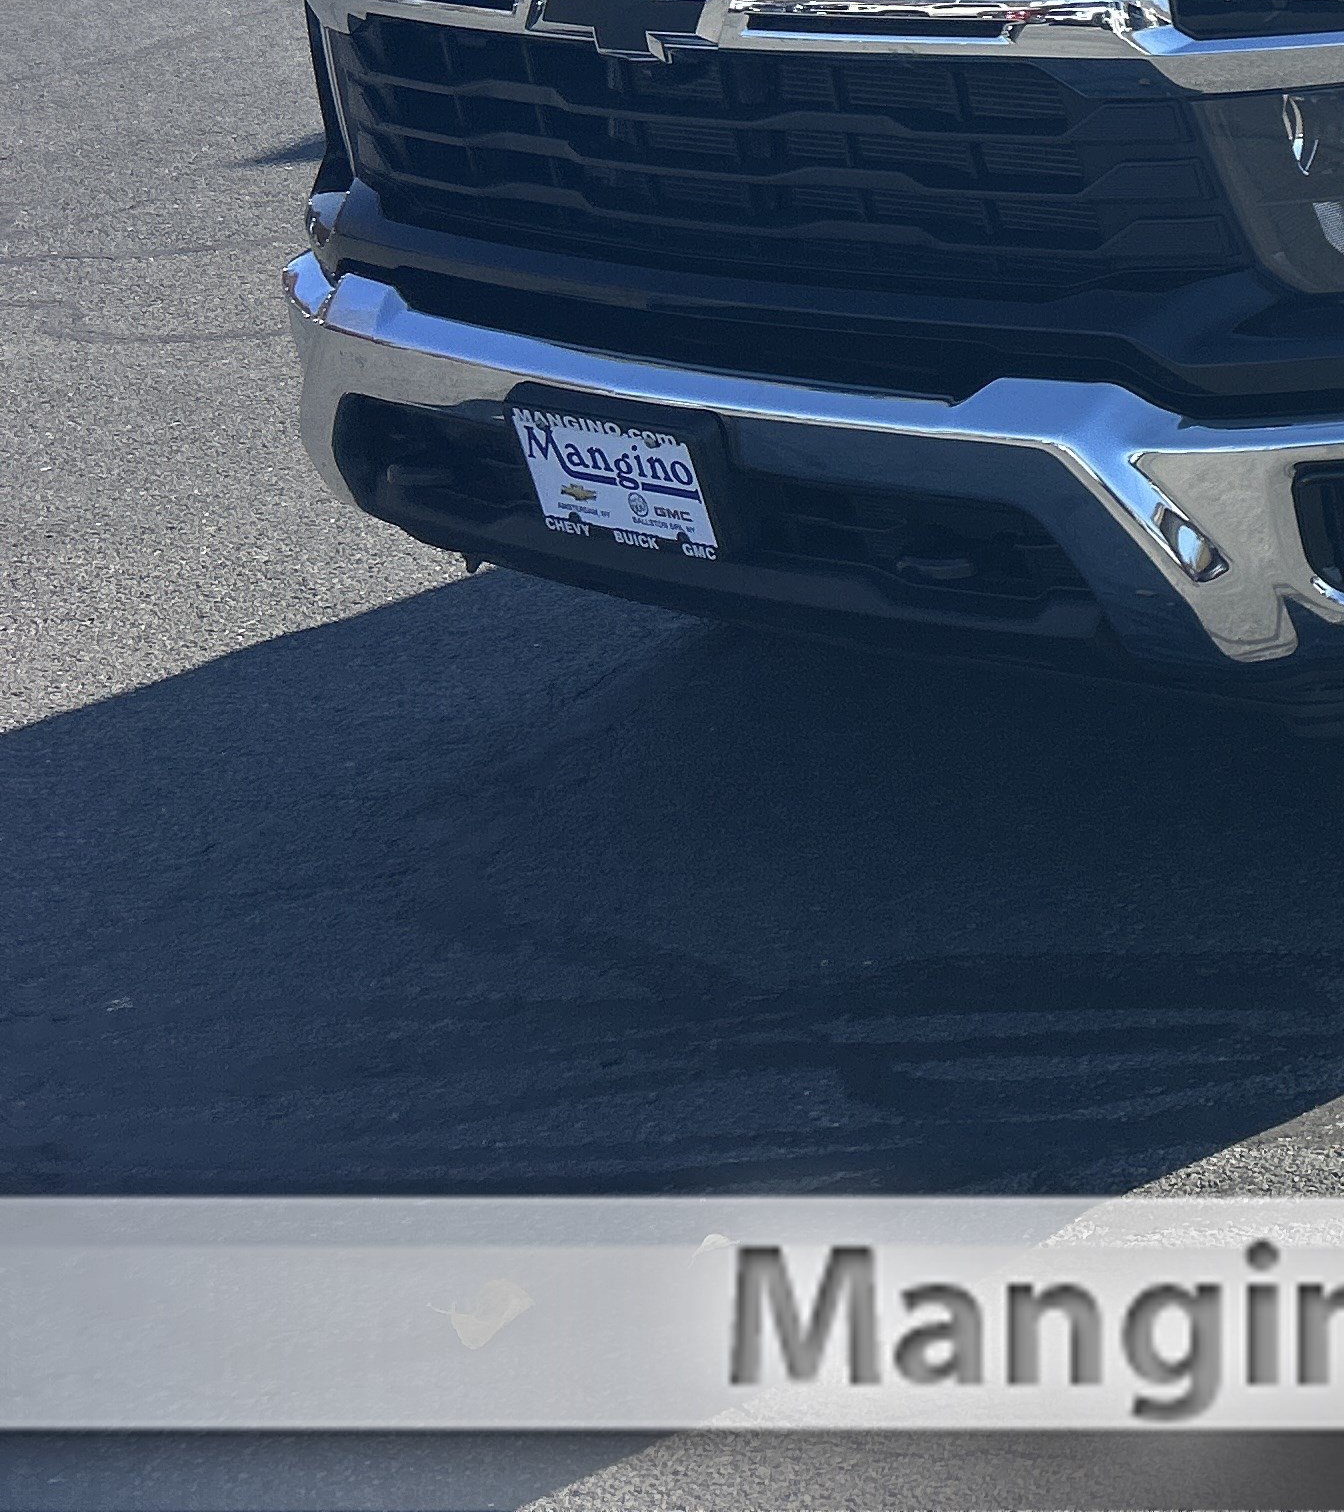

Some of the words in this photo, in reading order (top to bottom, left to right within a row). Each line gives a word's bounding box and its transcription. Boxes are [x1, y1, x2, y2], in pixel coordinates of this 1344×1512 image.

[523, 425, 702, 504] Mangino
[654, 505, 694, 523] GMC
[545, 518, 591, 537] CHEVY
[613, 530, 660, 551] BUICK
[682, 543, 718, 561] GMC
